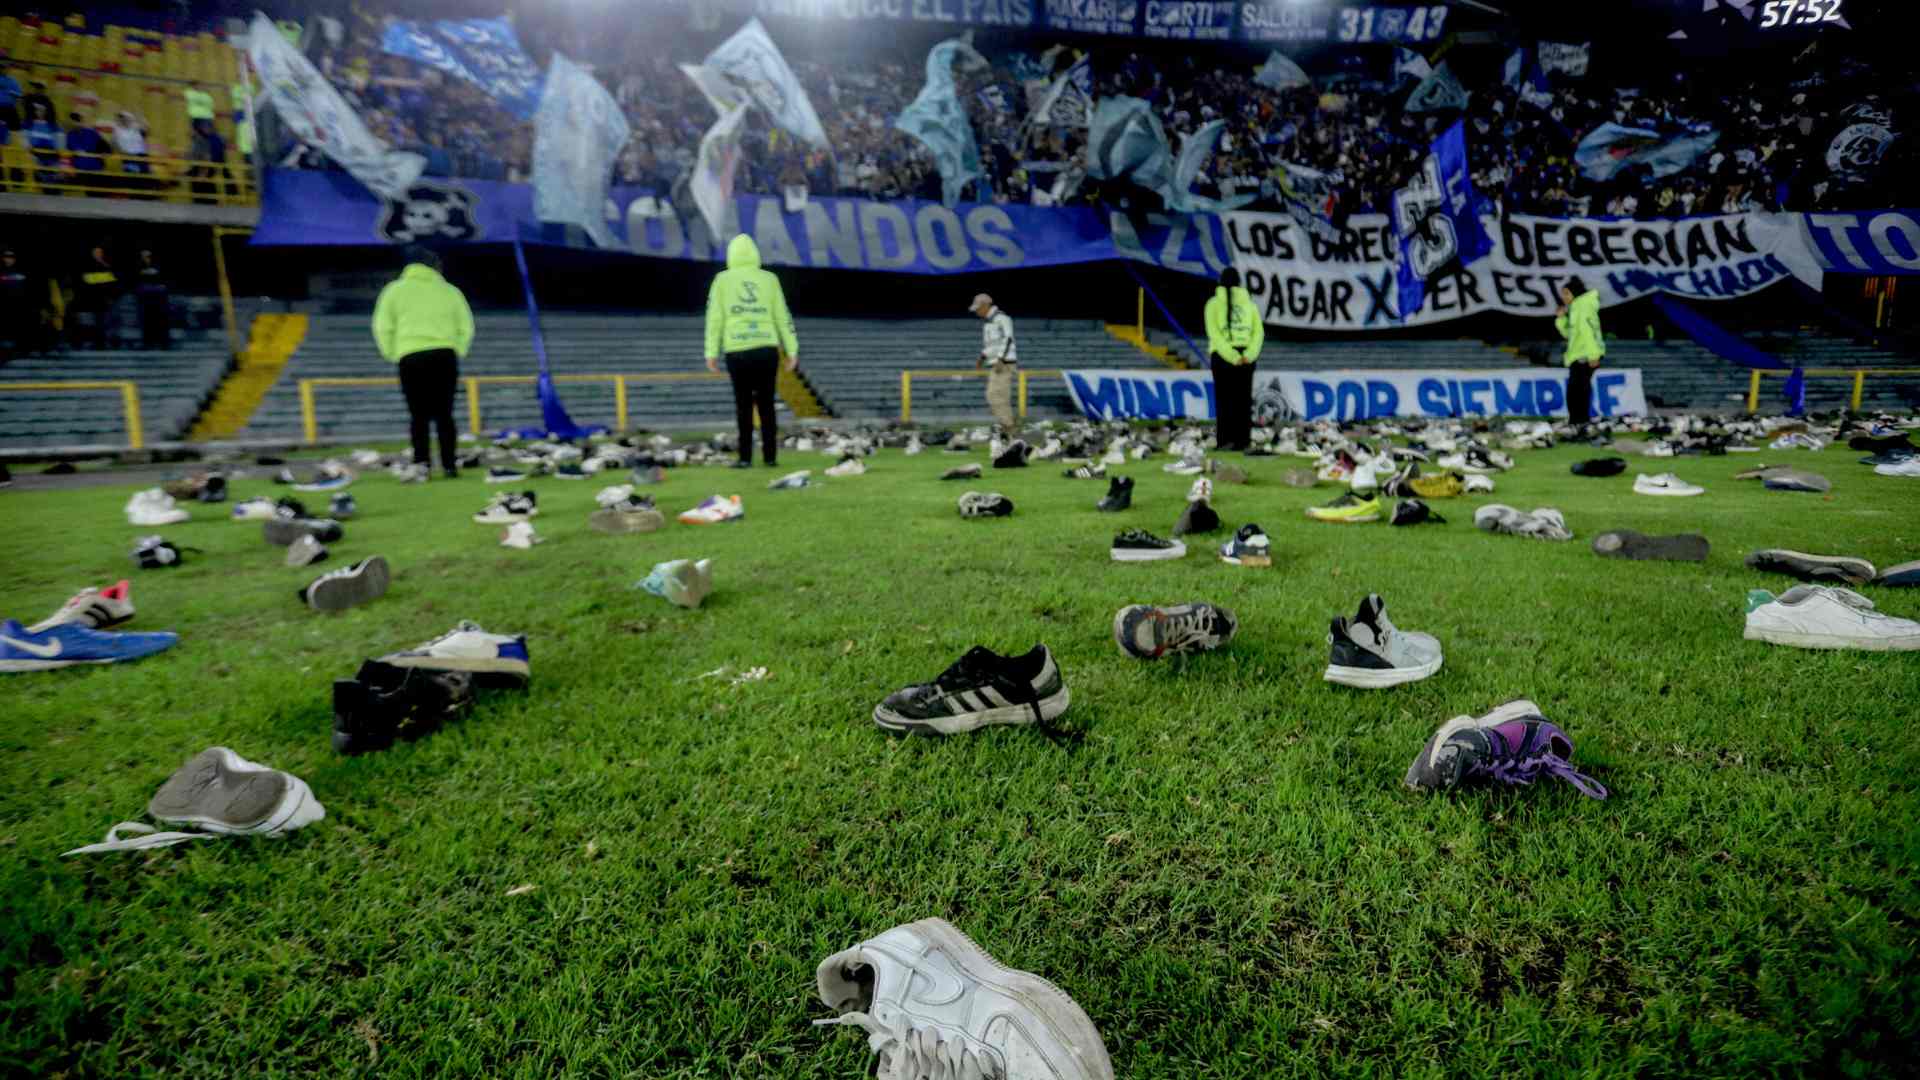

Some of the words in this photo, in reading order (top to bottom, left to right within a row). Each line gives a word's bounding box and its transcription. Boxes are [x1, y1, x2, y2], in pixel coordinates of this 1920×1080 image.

[1340, 8, 1376, 43] 31
[1405, 5, 1449, 42] 43
[1760, 0, 1842, 28] 57:52
[1228, 220, 1295, 260] LOS
[1501, 218, 1758, 268] DEBERIAN
[1245, 269, 1354, 325] PAGAR
[1356, 268, 1401, 325] X
[1302, 379, 1399, 422] POR
[1417, 373, 1626, 417] SIEMPE
